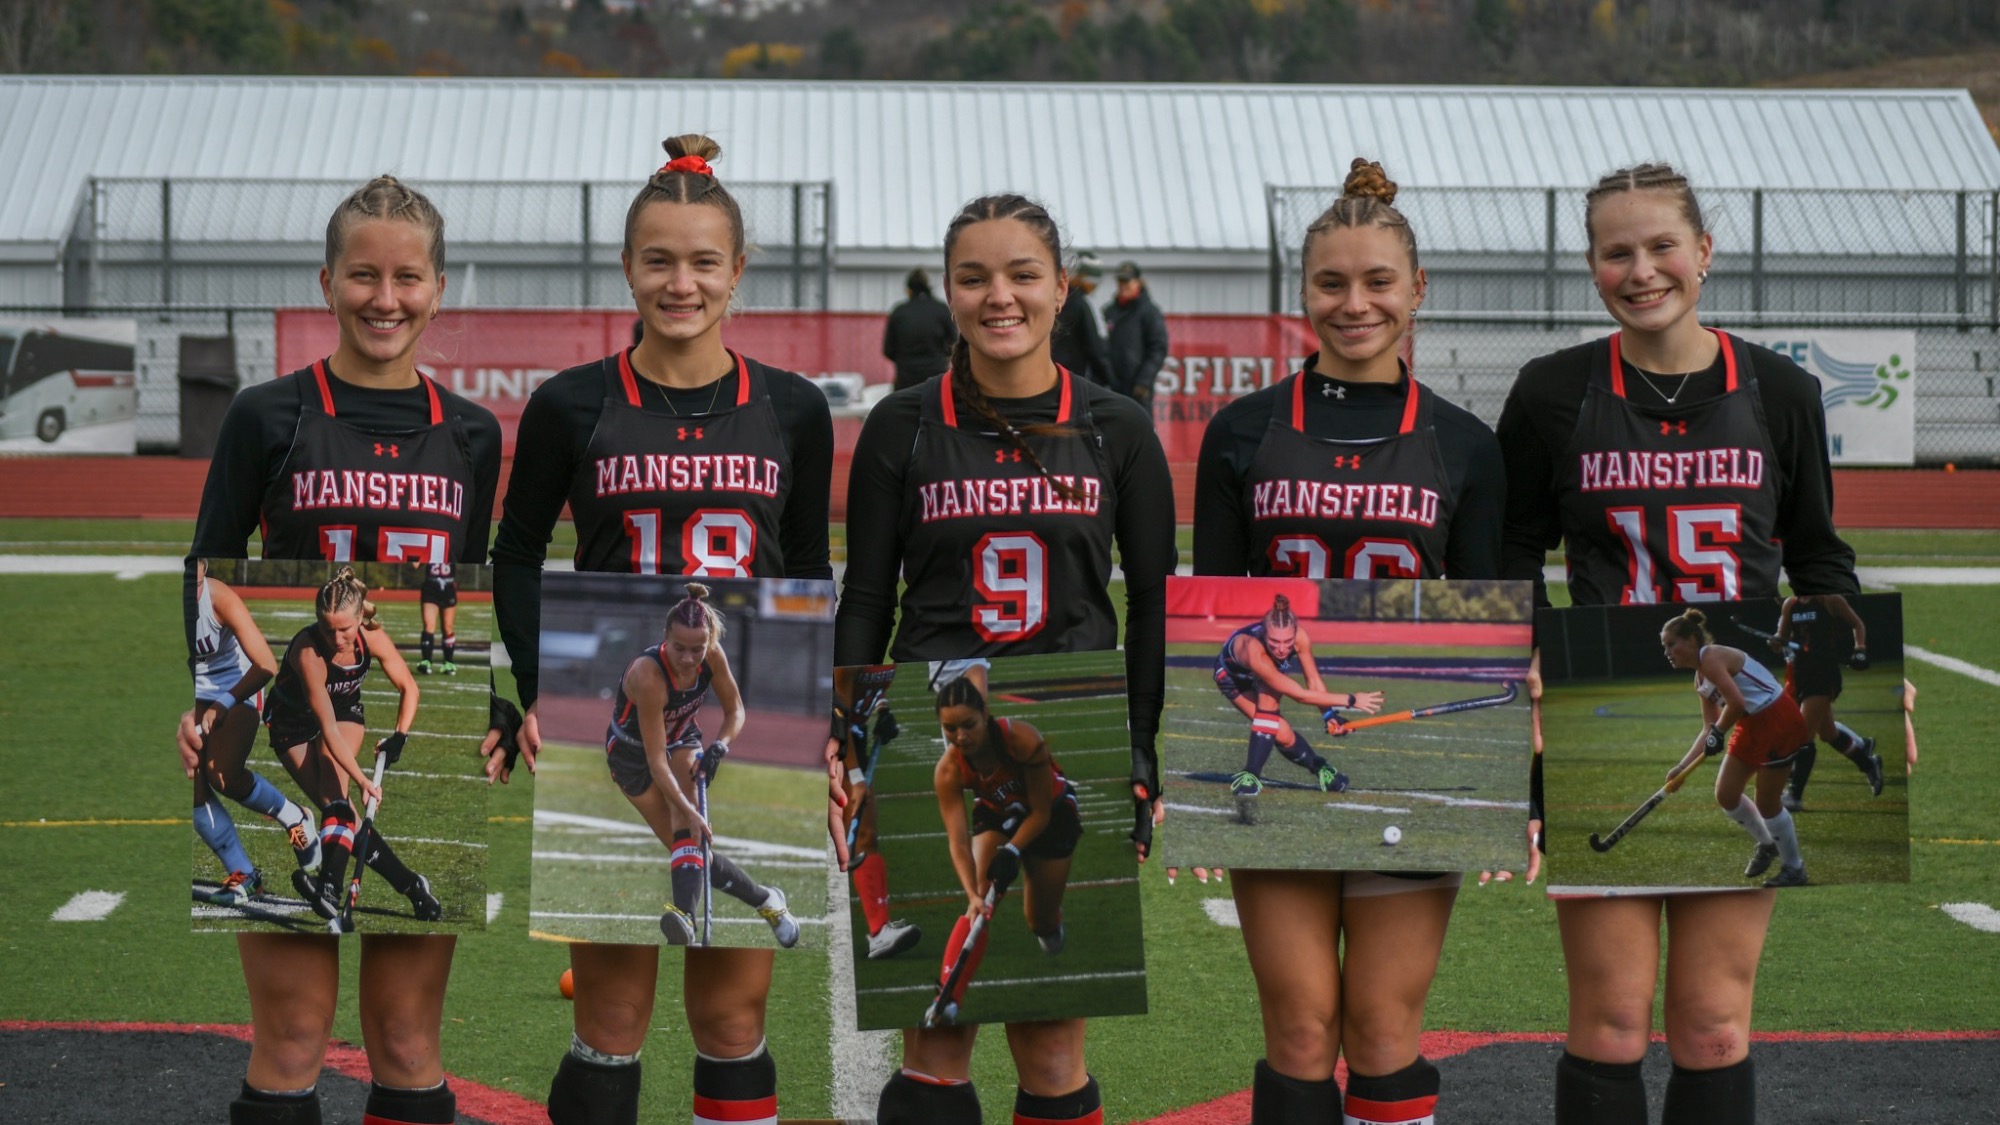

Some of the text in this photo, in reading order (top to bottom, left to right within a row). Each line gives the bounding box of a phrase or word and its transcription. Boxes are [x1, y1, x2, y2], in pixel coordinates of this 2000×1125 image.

[596, 454, 780, 498] MANSFIELD
[1580, 448, 1764, 492] MANSFIELD
[293, 470, 463, 521] MANSFIELD
[919, 475, 1101, 523] MANSFIELD
[1253, 479, 1440, 528] MANSFIELD
[623, 508, 757, 578] 18
[1605, 503, 1742, 606] 15
[972, 531, 1048, 642] 9
